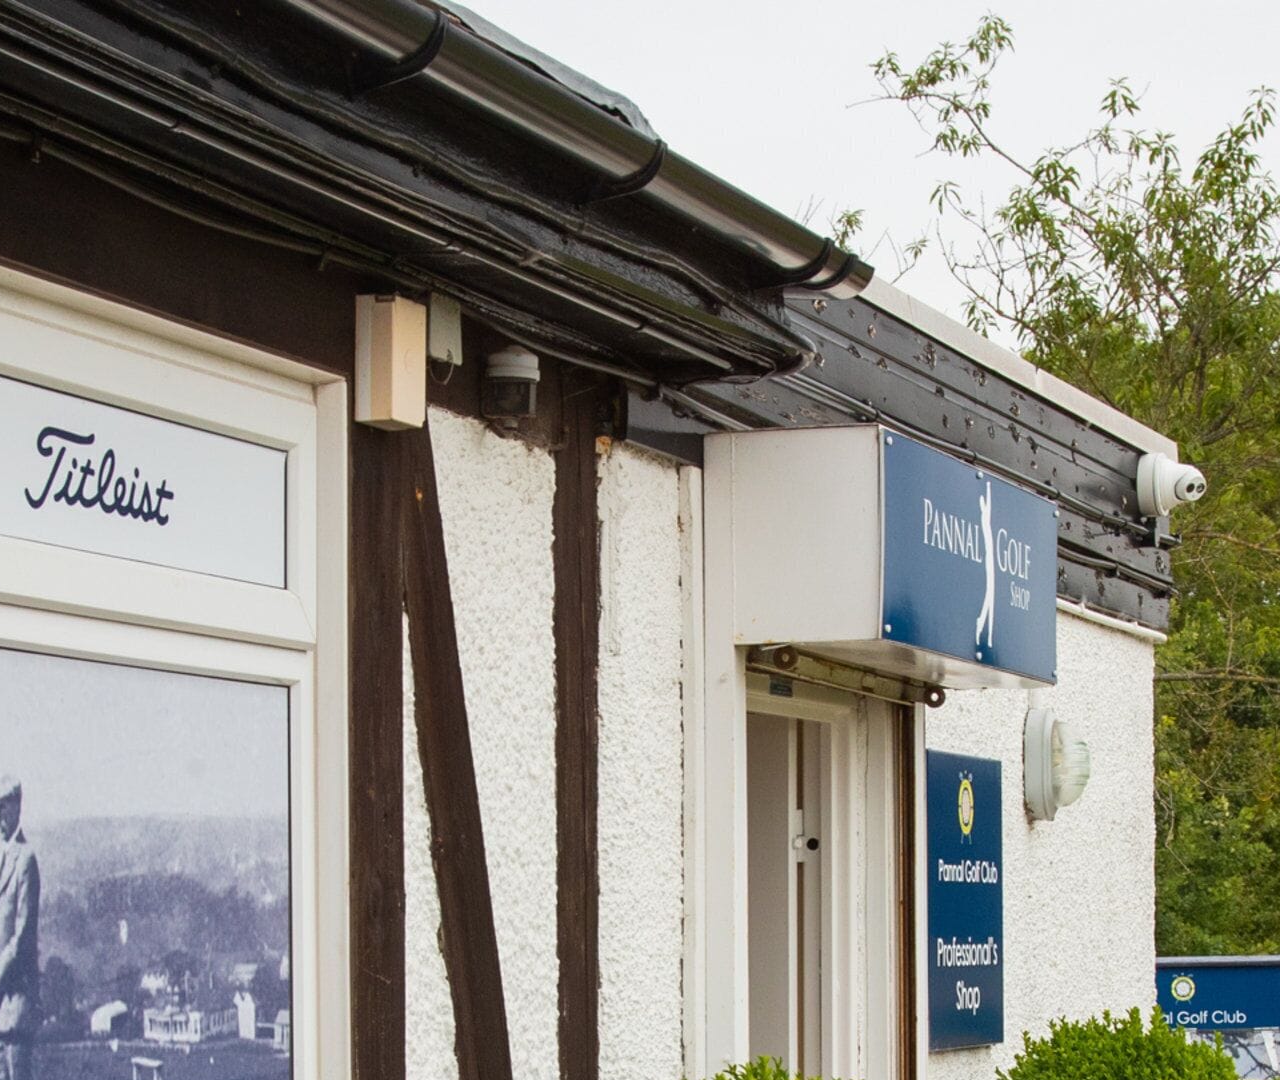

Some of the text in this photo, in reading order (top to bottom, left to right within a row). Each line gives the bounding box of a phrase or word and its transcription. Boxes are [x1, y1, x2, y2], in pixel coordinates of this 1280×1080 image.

[24, 426, 174, 526] Titleist
[923, 498, 1031, 580] PANNAL GOLF
[1009, 581, 1031, 612] SHOP
[937, 858, 999, 884] Pannal Golf Club
[937, 936, 999, 967] Professional's
[955, 979, 981, 1015] Shop
[1176, 1010, 1209, 1025] Golf
[1211, 1009, 1247, 1024] Club
